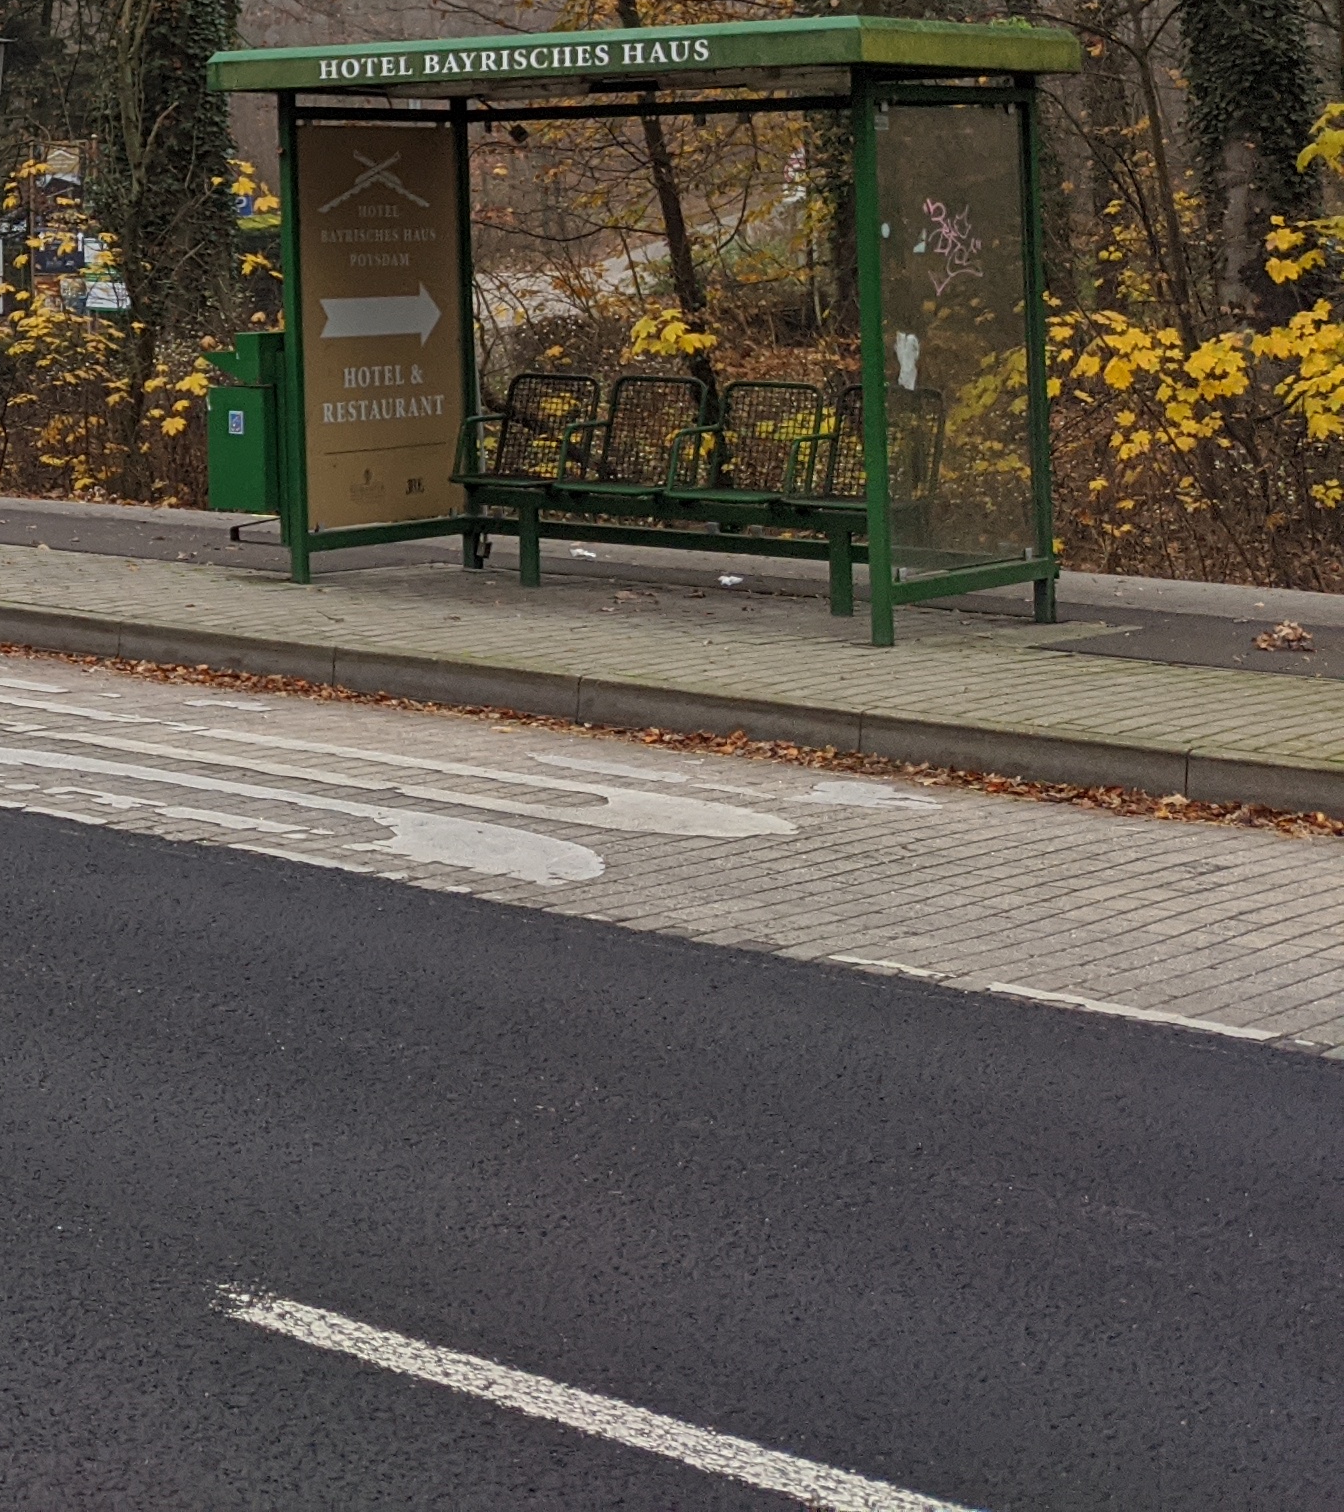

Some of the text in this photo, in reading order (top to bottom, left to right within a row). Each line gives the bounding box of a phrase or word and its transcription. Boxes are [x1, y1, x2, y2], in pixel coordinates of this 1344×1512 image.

[319, 39, 710, 80] HOTEL BAYRISCHES HAUS
[358, 205, 400, 218] HOTEL
[321, 228, 437, 243] BAYRISCHES HAUS
[350, 253, 410, 267] POTSDAM
[344, 364, 424, 388] HOTEL &
[323, 394, 446, 424] RESTAURANT
